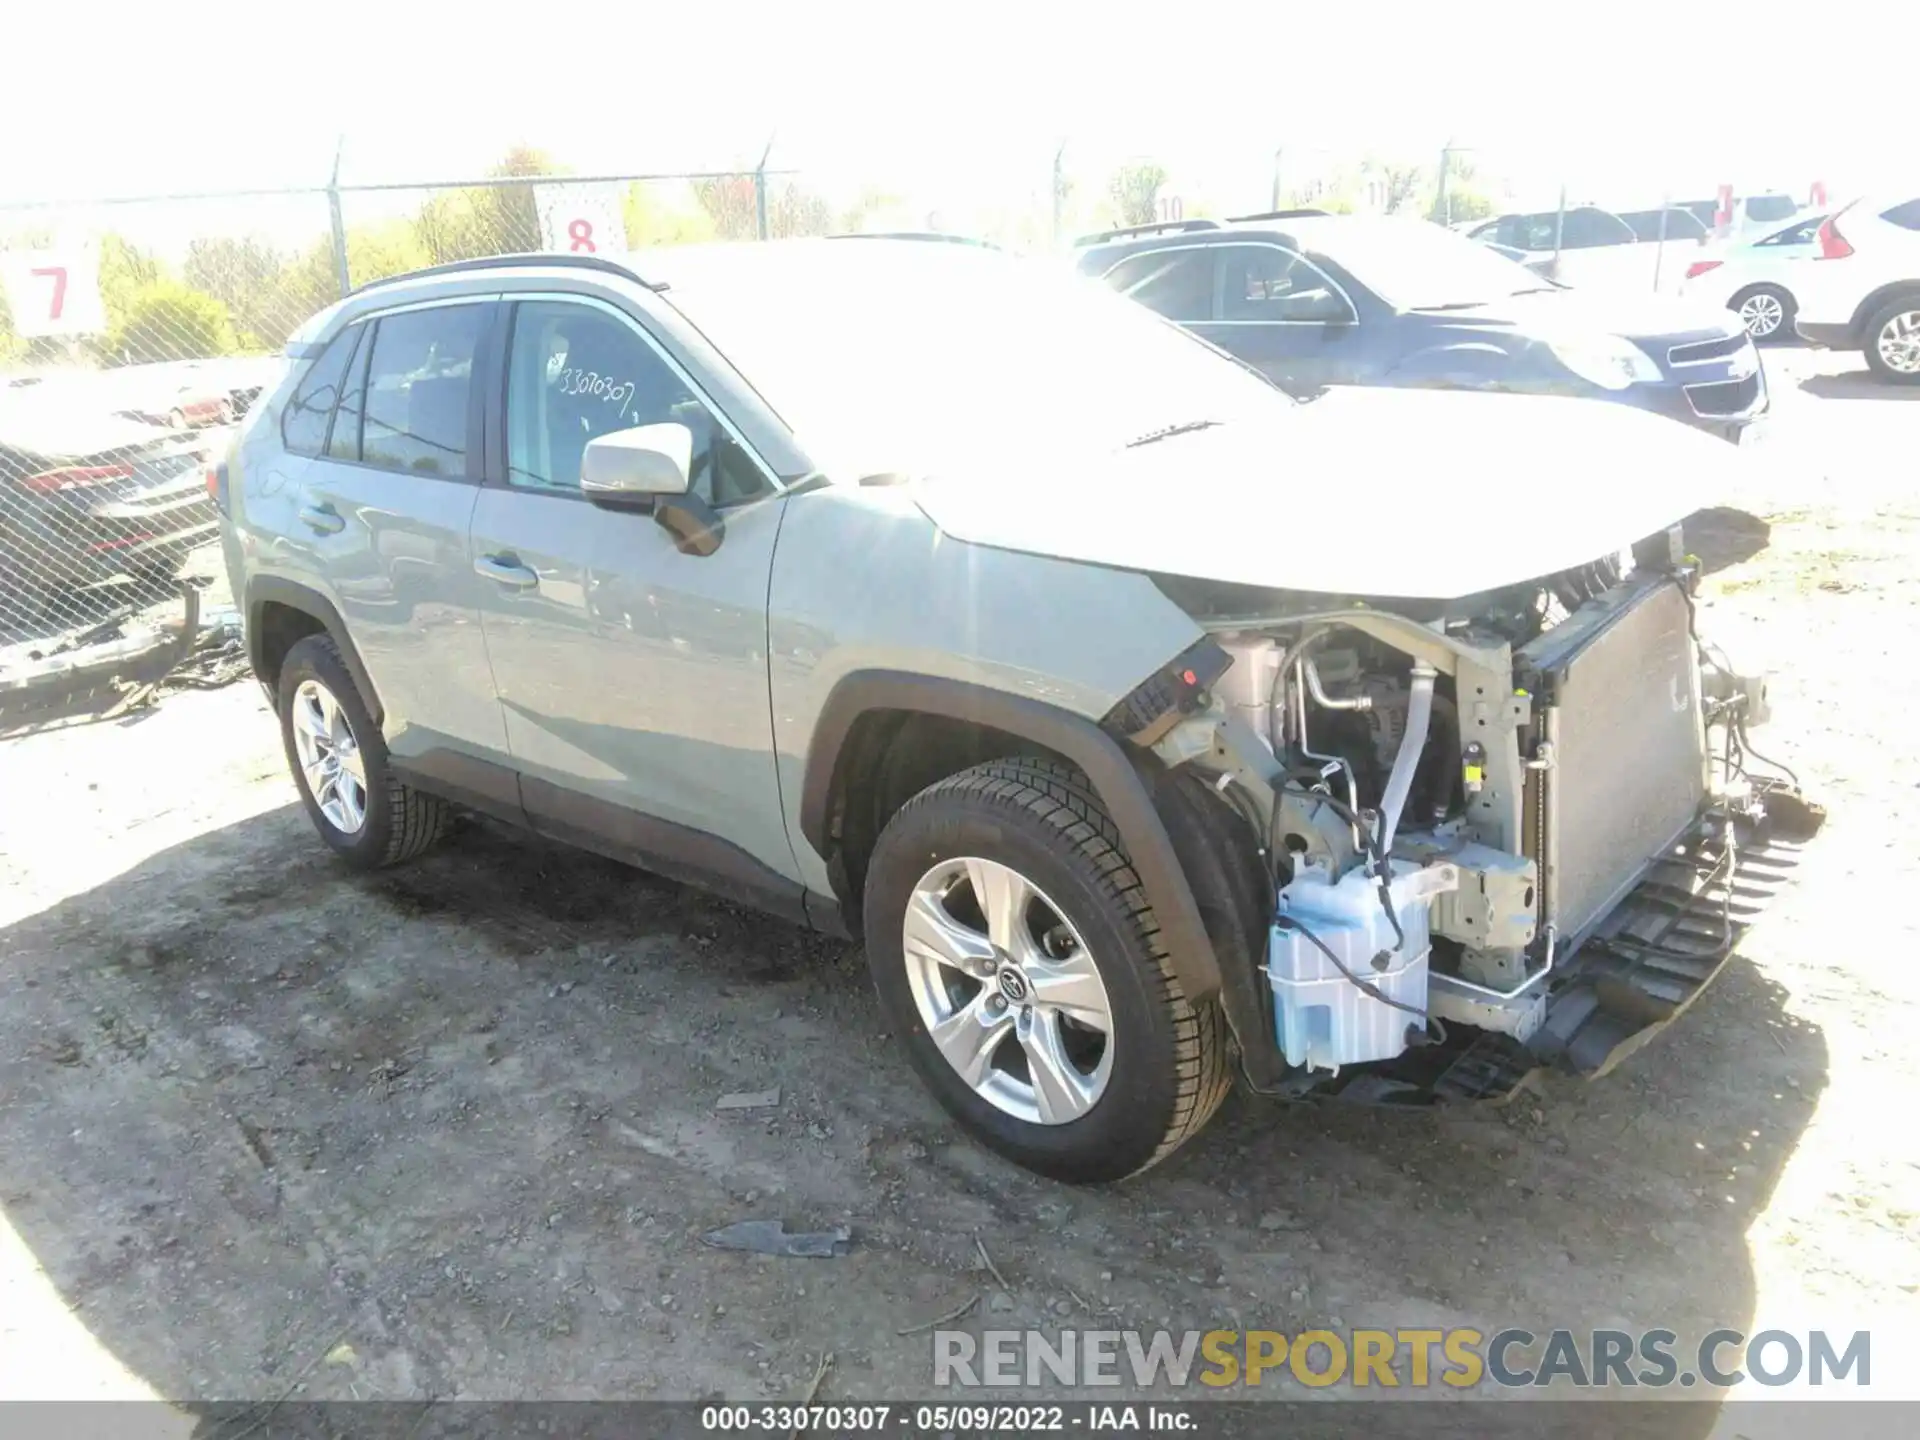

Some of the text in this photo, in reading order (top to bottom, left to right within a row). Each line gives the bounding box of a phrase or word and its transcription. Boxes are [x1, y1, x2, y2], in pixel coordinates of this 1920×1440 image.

[568, 218, 596, 253] 8
[30, 266, 67, 319] 7
[558, 367, 636, 419] 33070307
